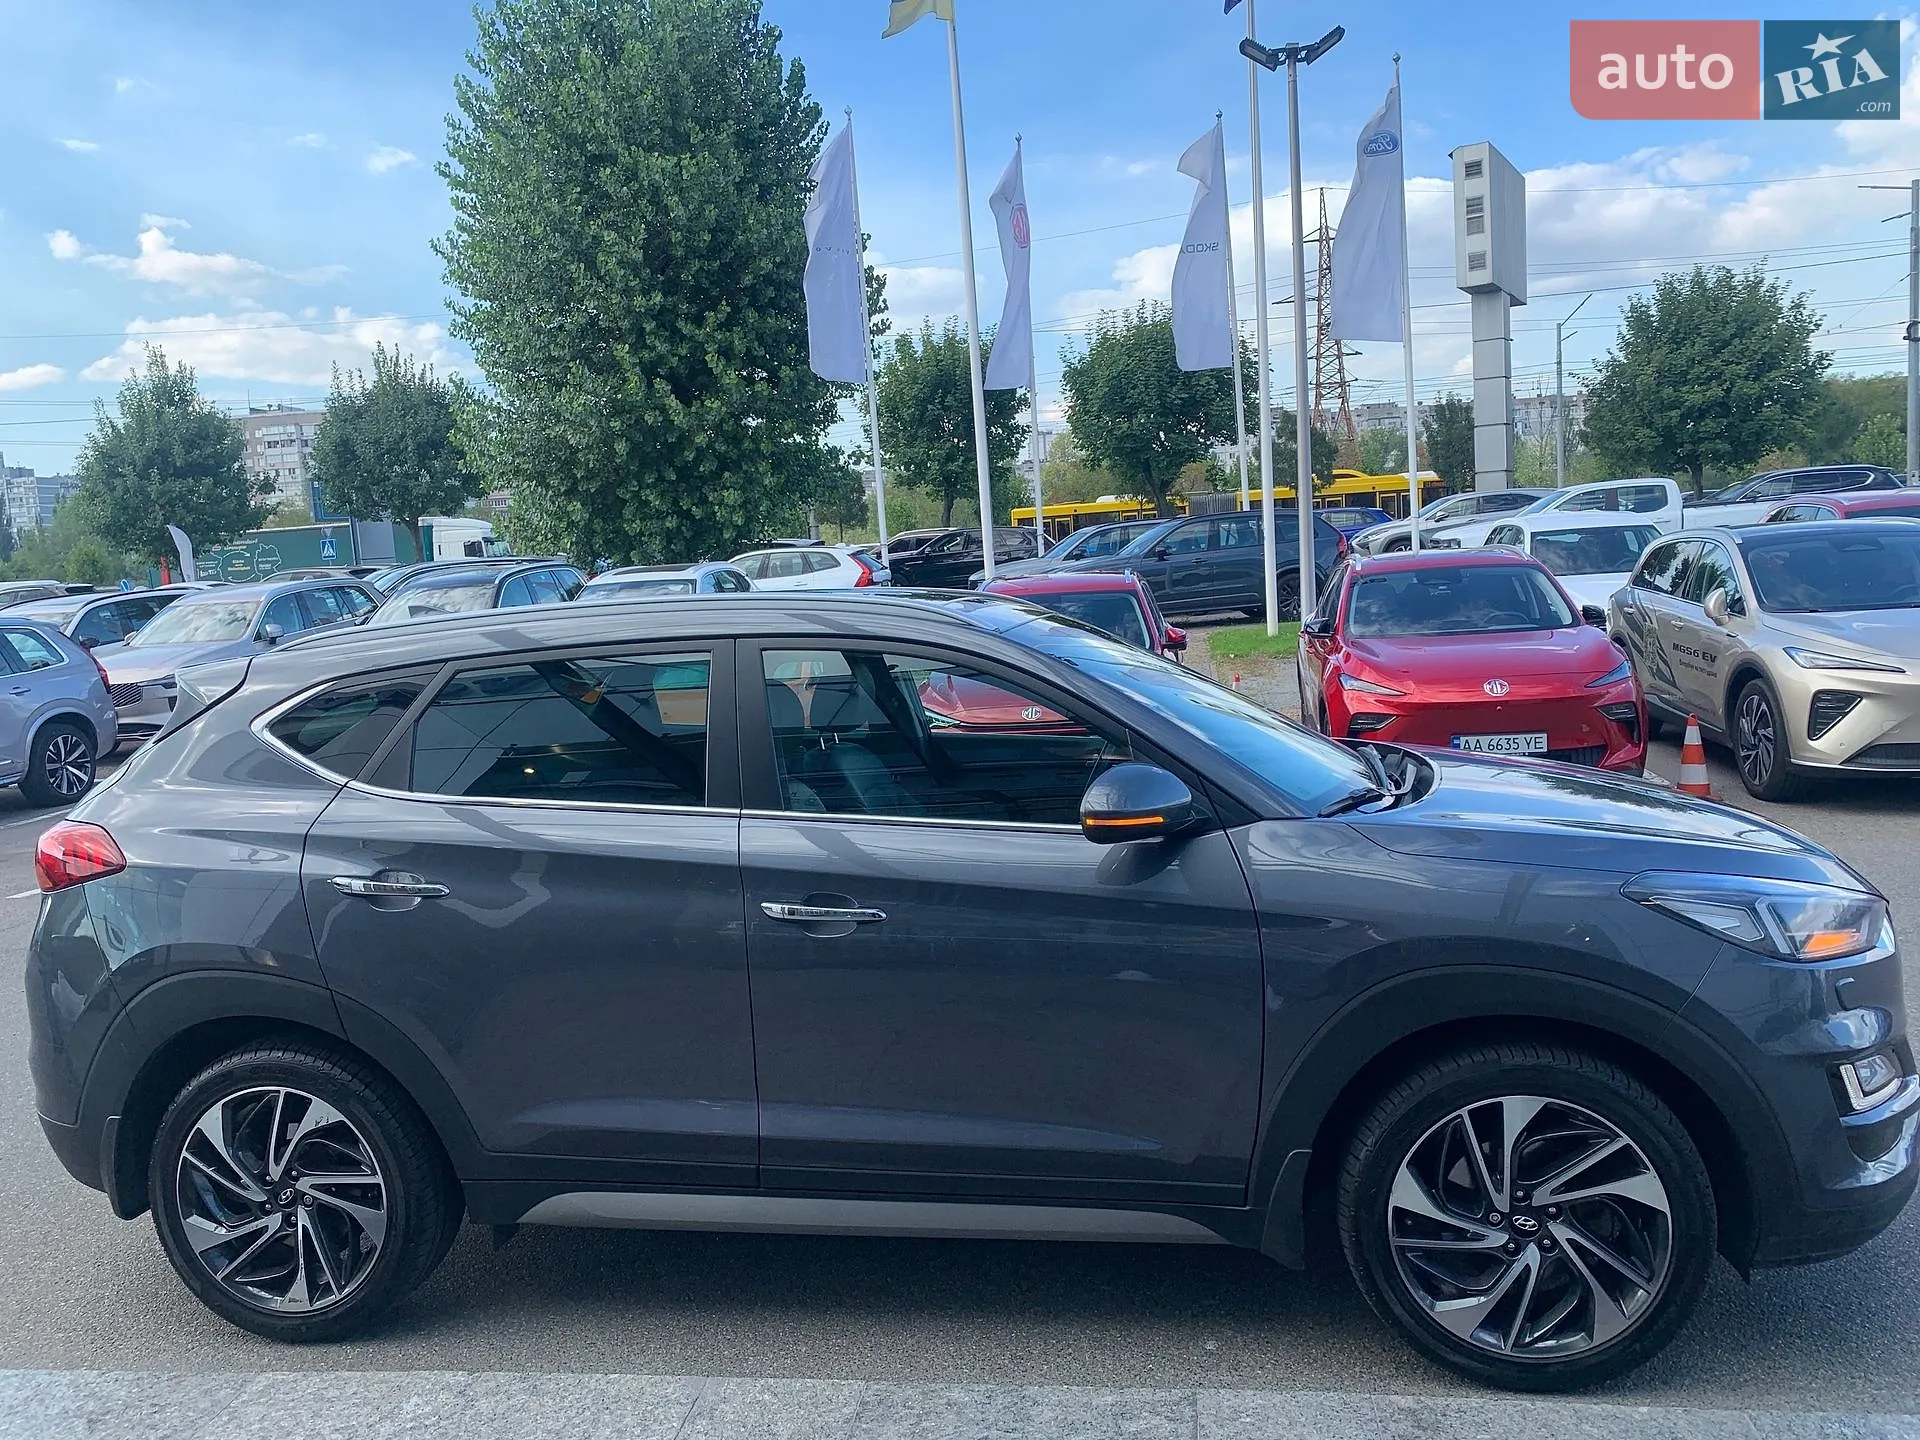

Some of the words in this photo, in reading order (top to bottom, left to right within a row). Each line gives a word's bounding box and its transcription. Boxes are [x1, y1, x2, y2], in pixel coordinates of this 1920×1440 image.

[1672, 642, 1700, 658] MGS6
[1702, 651, 1718, 663] EV
[1484, 679, 1509, 696] MG
[1022, 706, 1041, 720] MG
[1463, 738, 1483, 752] AA
[1487, 737, 1520, 751] 6635
[1524, 736, 1544, 750] YE
